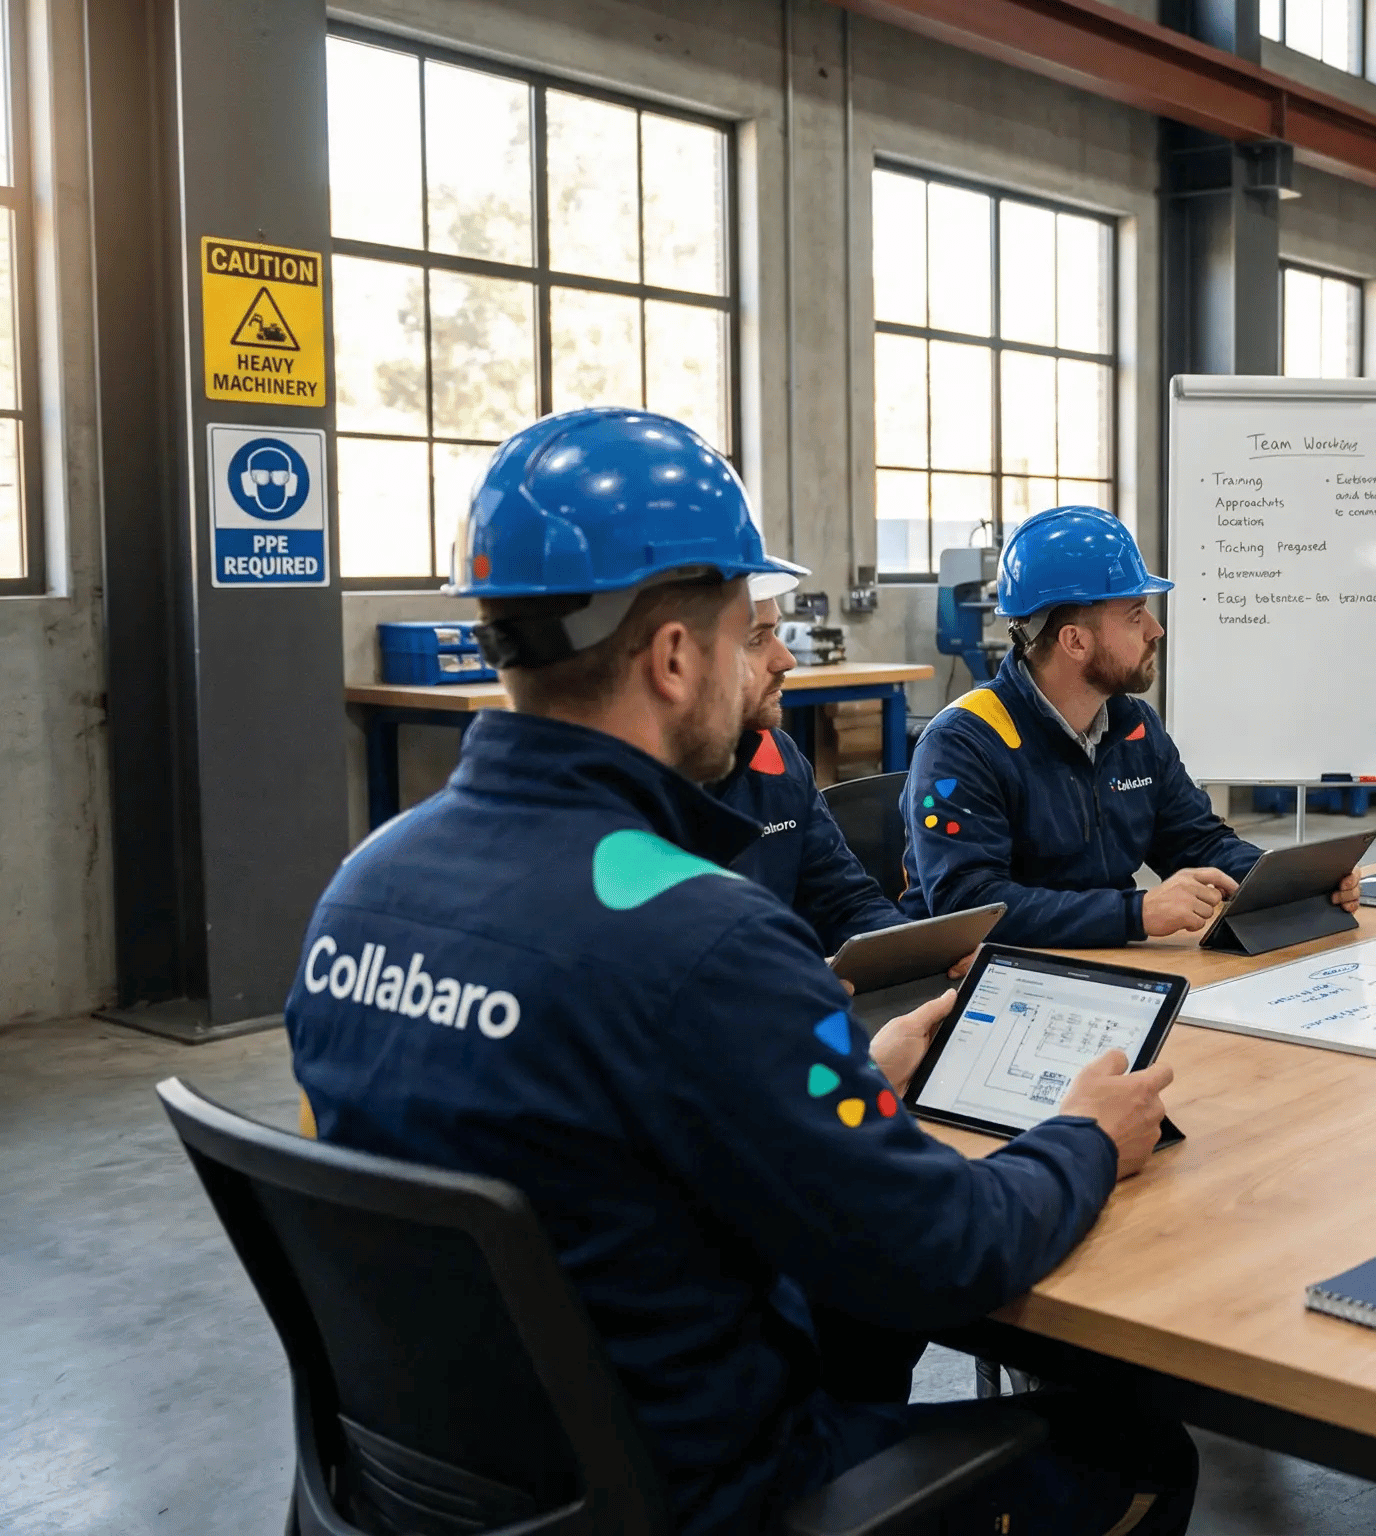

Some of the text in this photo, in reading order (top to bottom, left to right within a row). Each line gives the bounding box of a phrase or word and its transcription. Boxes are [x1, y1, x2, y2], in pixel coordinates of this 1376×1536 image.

[211, 247, 315, 283] CAUTION
[237, 354, 295, 374] HEAVY
[213, 374, 318, 397] MACHINERY
[1247, 433, 1292, 451] Team
[1212, 472, 1263, 491] Training
[253, 535, 289, 553] PPE
[224, 557, 318, 579] REQUIRED
[304, 935, 521, 1039] Collabaro
